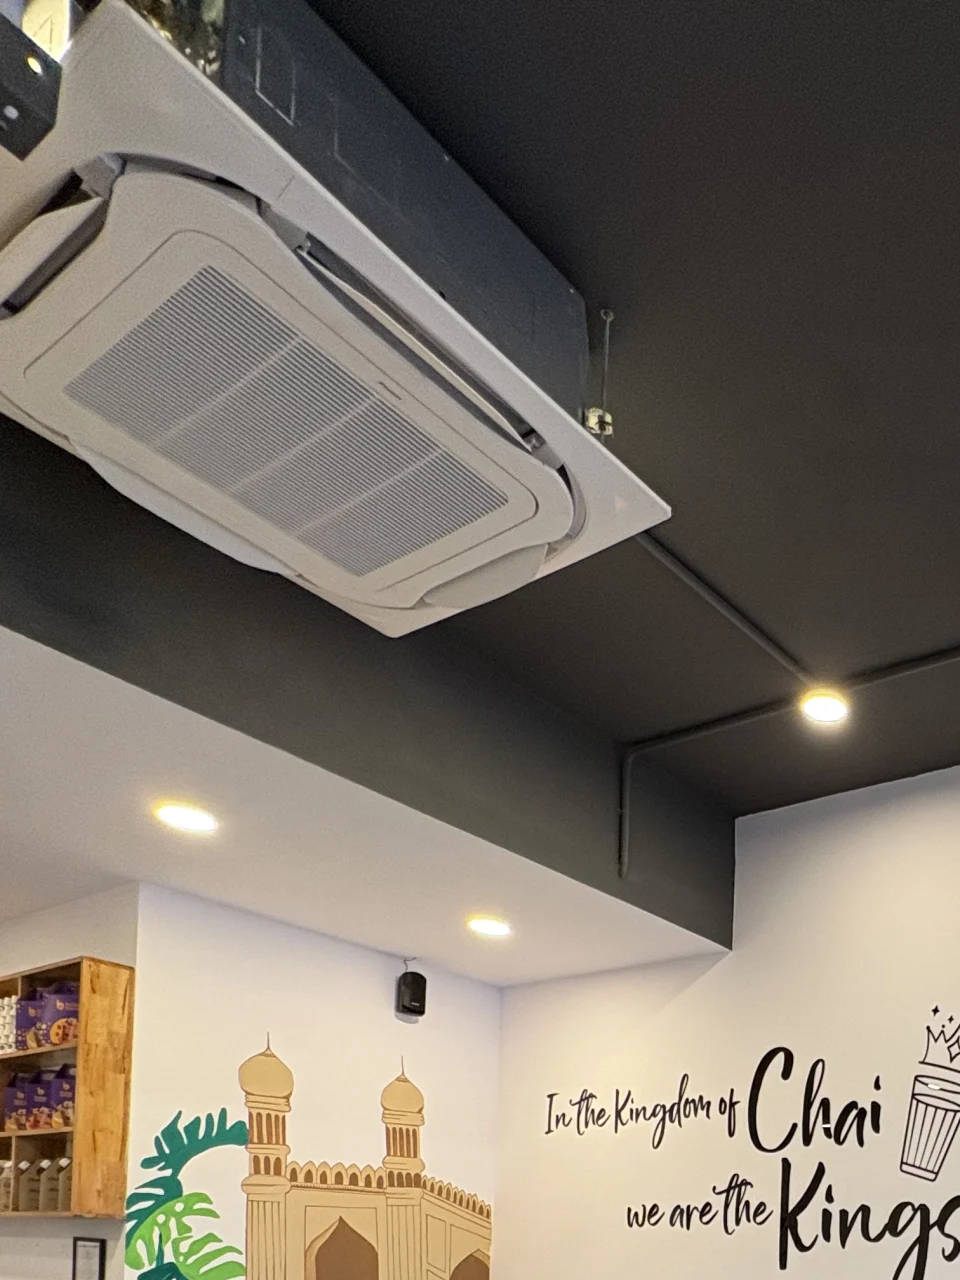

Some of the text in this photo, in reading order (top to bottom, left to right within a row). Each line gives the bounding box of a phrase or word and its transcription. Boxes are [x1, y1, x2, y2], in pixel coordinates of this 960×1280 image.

[544, 1046, 882, 1154] In the Kingdom of Chai
[626, 1202, 666, 1229] we
[668, 1200, 719, 1232] are
[711, 1172, 775, 1236] the
